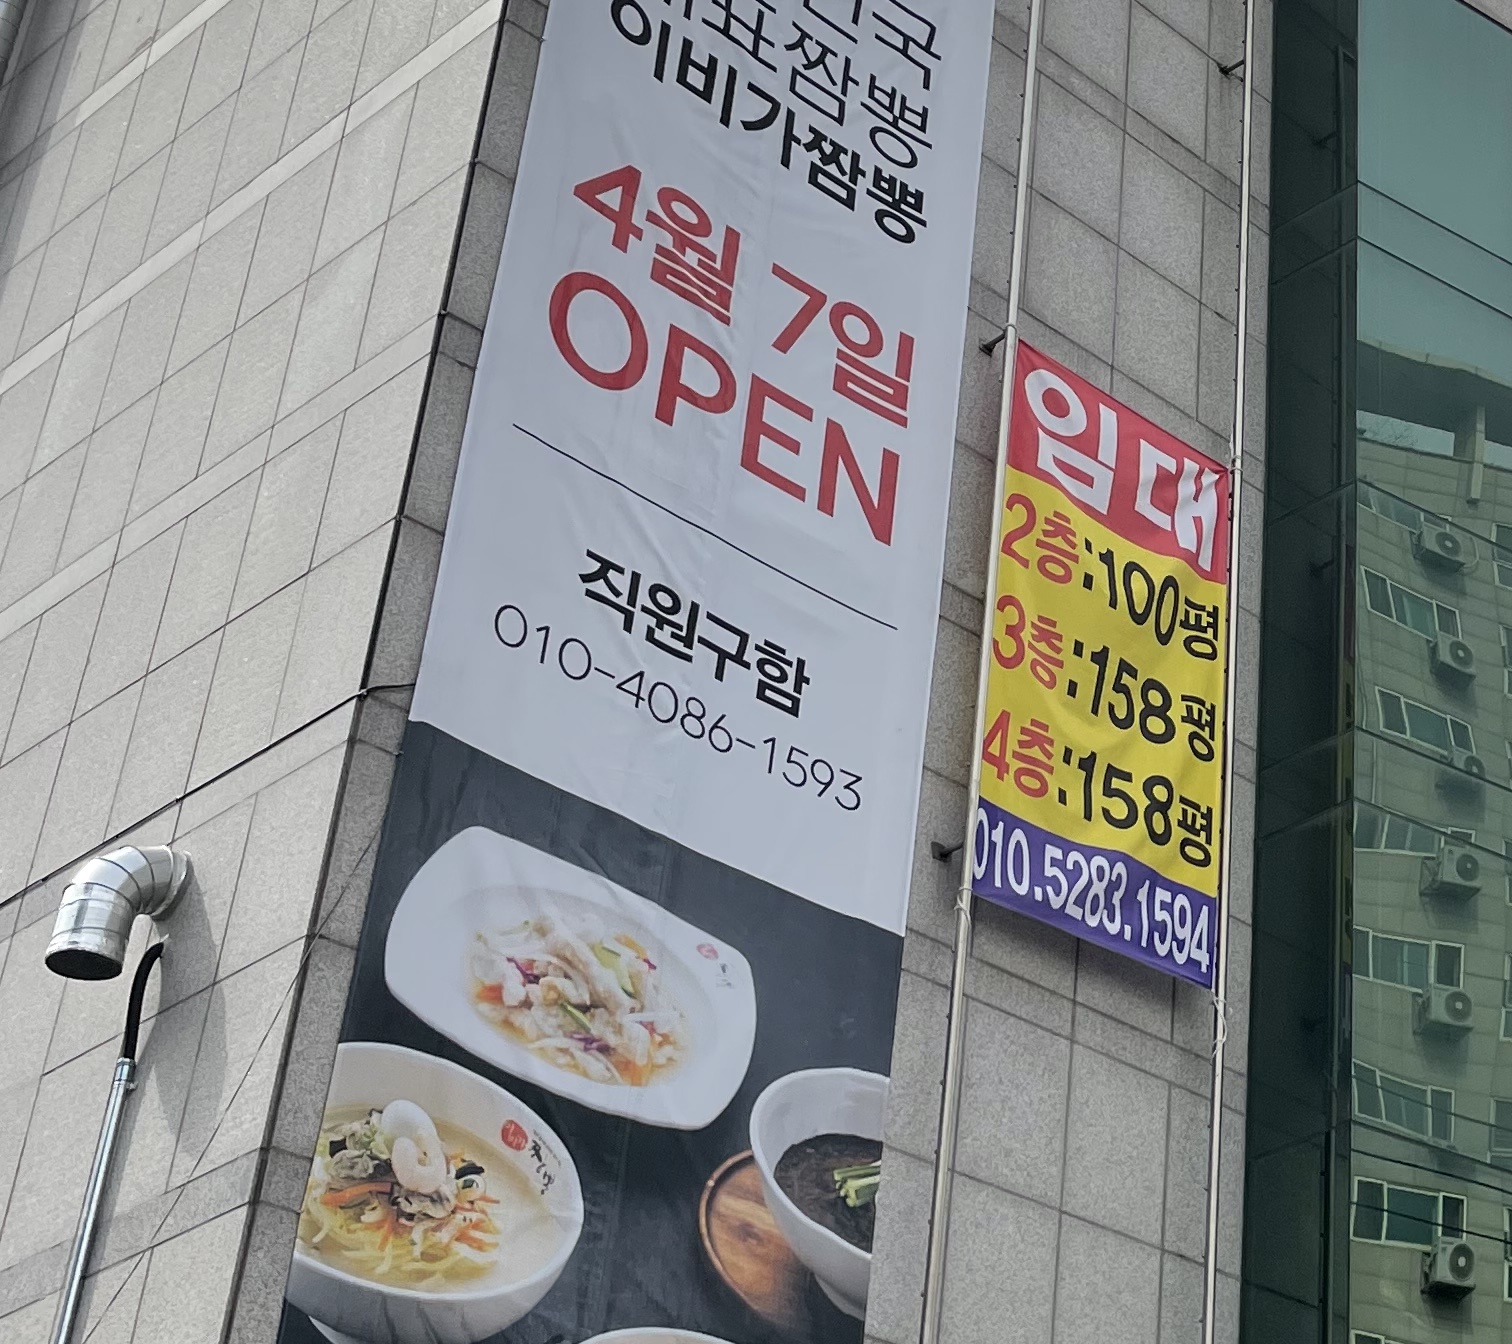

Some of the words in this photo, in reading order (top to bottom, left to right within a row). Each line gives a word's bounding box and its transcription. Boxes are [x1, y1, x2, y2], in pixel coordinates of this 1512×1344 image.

[573, 165, 741, 325] 4월
[771, 263, 915, 429] 7일
[549, 272, 899, 547] OPEN
[1024, 368, 1221, 574] 임대
[579, 550, 810, 718] 직원구함
[1001, 493, 1219, 662] 2층:100평
[494, 605, 862, 811] 010-4086-1593
[993, 595, 1216, 763] 3층:158평
[982, 709, 1214, 868] 4층:158평
[973, 808, 1211, 973] 010.5283.1594
